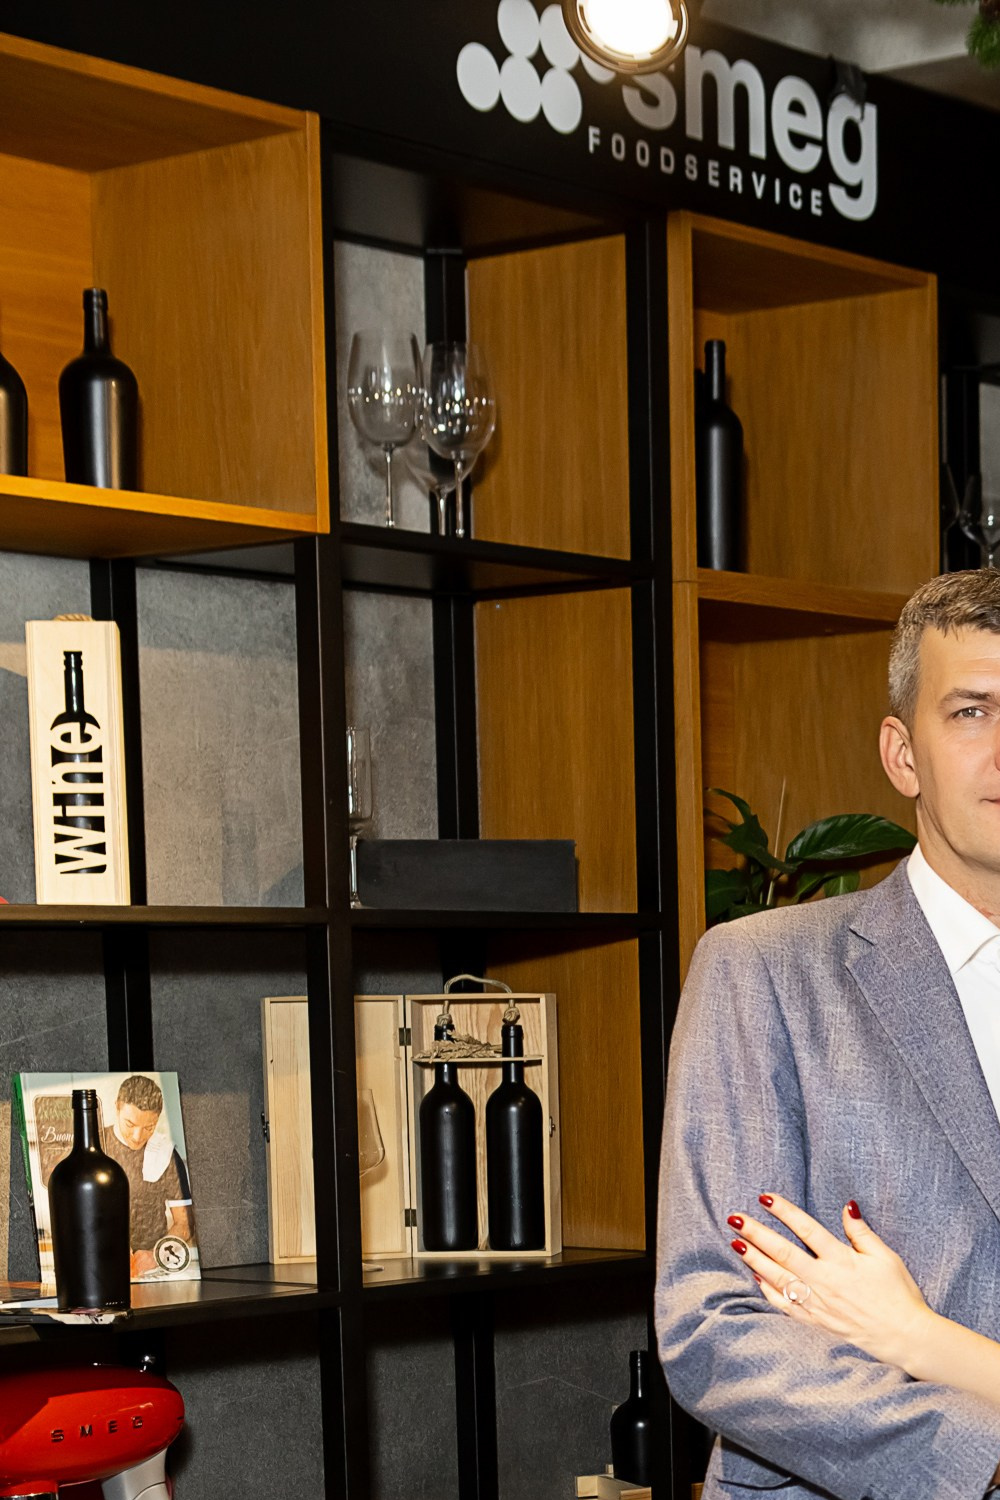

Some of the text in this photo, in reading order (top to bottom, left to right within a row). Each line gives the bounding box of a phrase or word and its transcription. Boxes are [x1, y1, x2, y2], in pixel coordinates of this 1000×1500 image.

[588, 126, 823, 216] FOODSERVICE
[622, 44, 878, 222] smeg
[50, 1415, 144, 1443] SMEG
